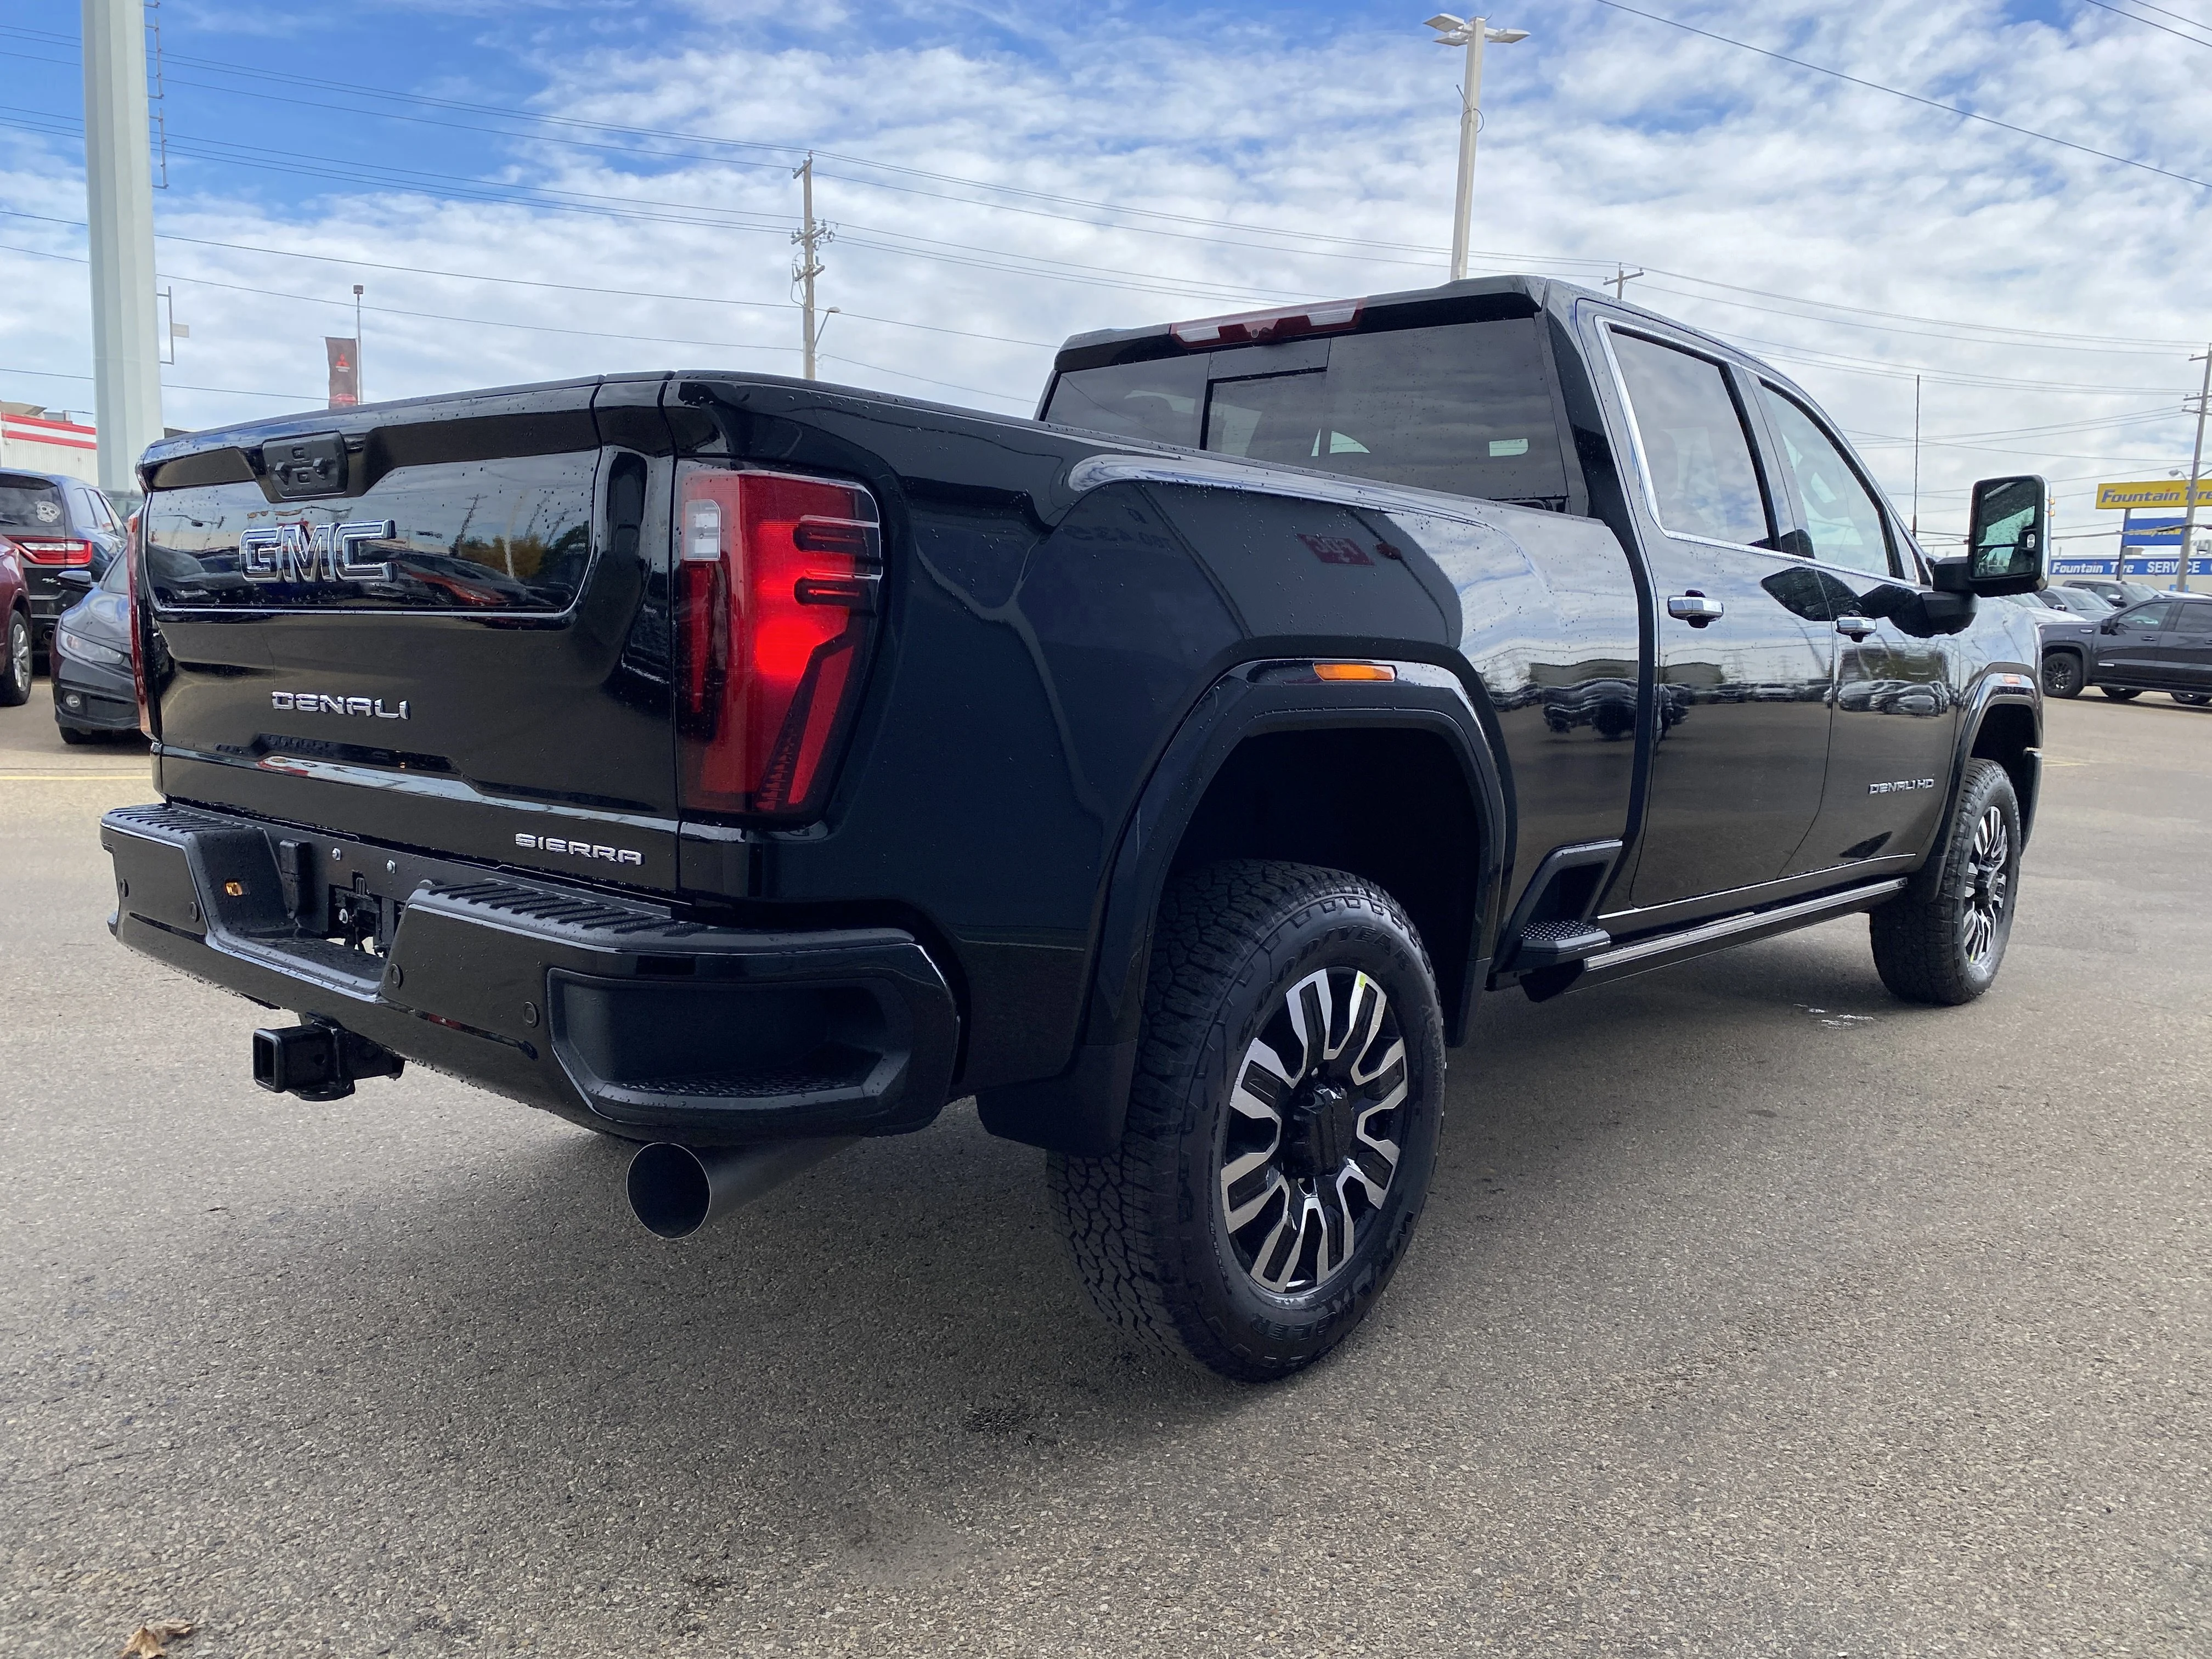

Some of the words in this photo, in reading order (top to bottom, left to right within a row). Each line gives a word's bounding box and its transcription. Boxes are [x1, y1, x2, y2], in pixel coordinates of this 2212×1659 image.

[2101, 488, 2180, 503] Fountain
[239, 519, 398, 583] GMC
[2052, 561, 2104, 573] Fountain
[2110, 561, 2134, 573] Tre
[2147, 561, 2201, 573] SERVCE
[272, 691, 410, 720] DENALI
[1868, 781, 1916, 794] DENALI
[1917, 778, 1934, 789] HD
[515, 833, 644, 866] SIERRA
